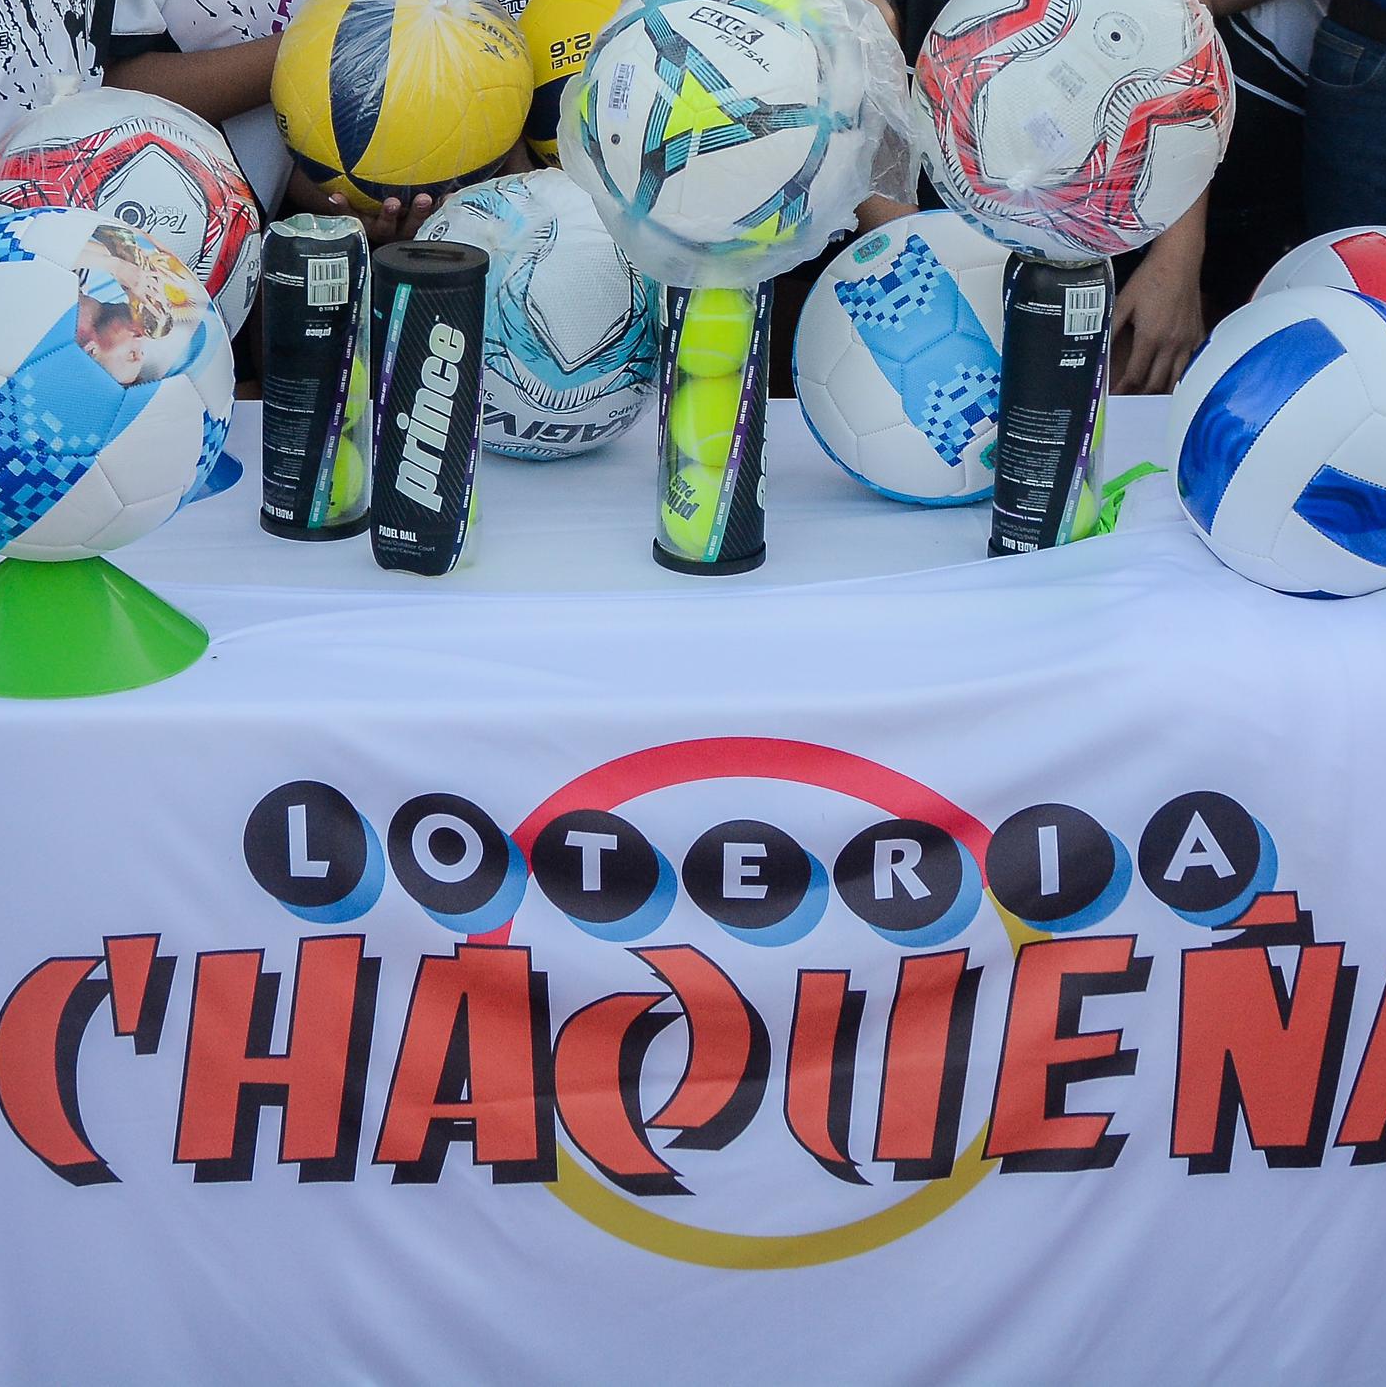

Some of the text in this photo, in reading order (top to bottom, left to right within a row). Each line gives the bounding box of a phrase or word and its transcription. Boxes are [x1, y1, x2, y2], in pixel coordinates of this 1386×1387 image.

[688, 6, 765, 45] SLICK
[715, 33, 771, 73] FUTSAL
[395, 322, 466, 513] prince
[379, 525, 417, 542] PADEL BALL
[283, 799, 1243, 902] LOTERIA
